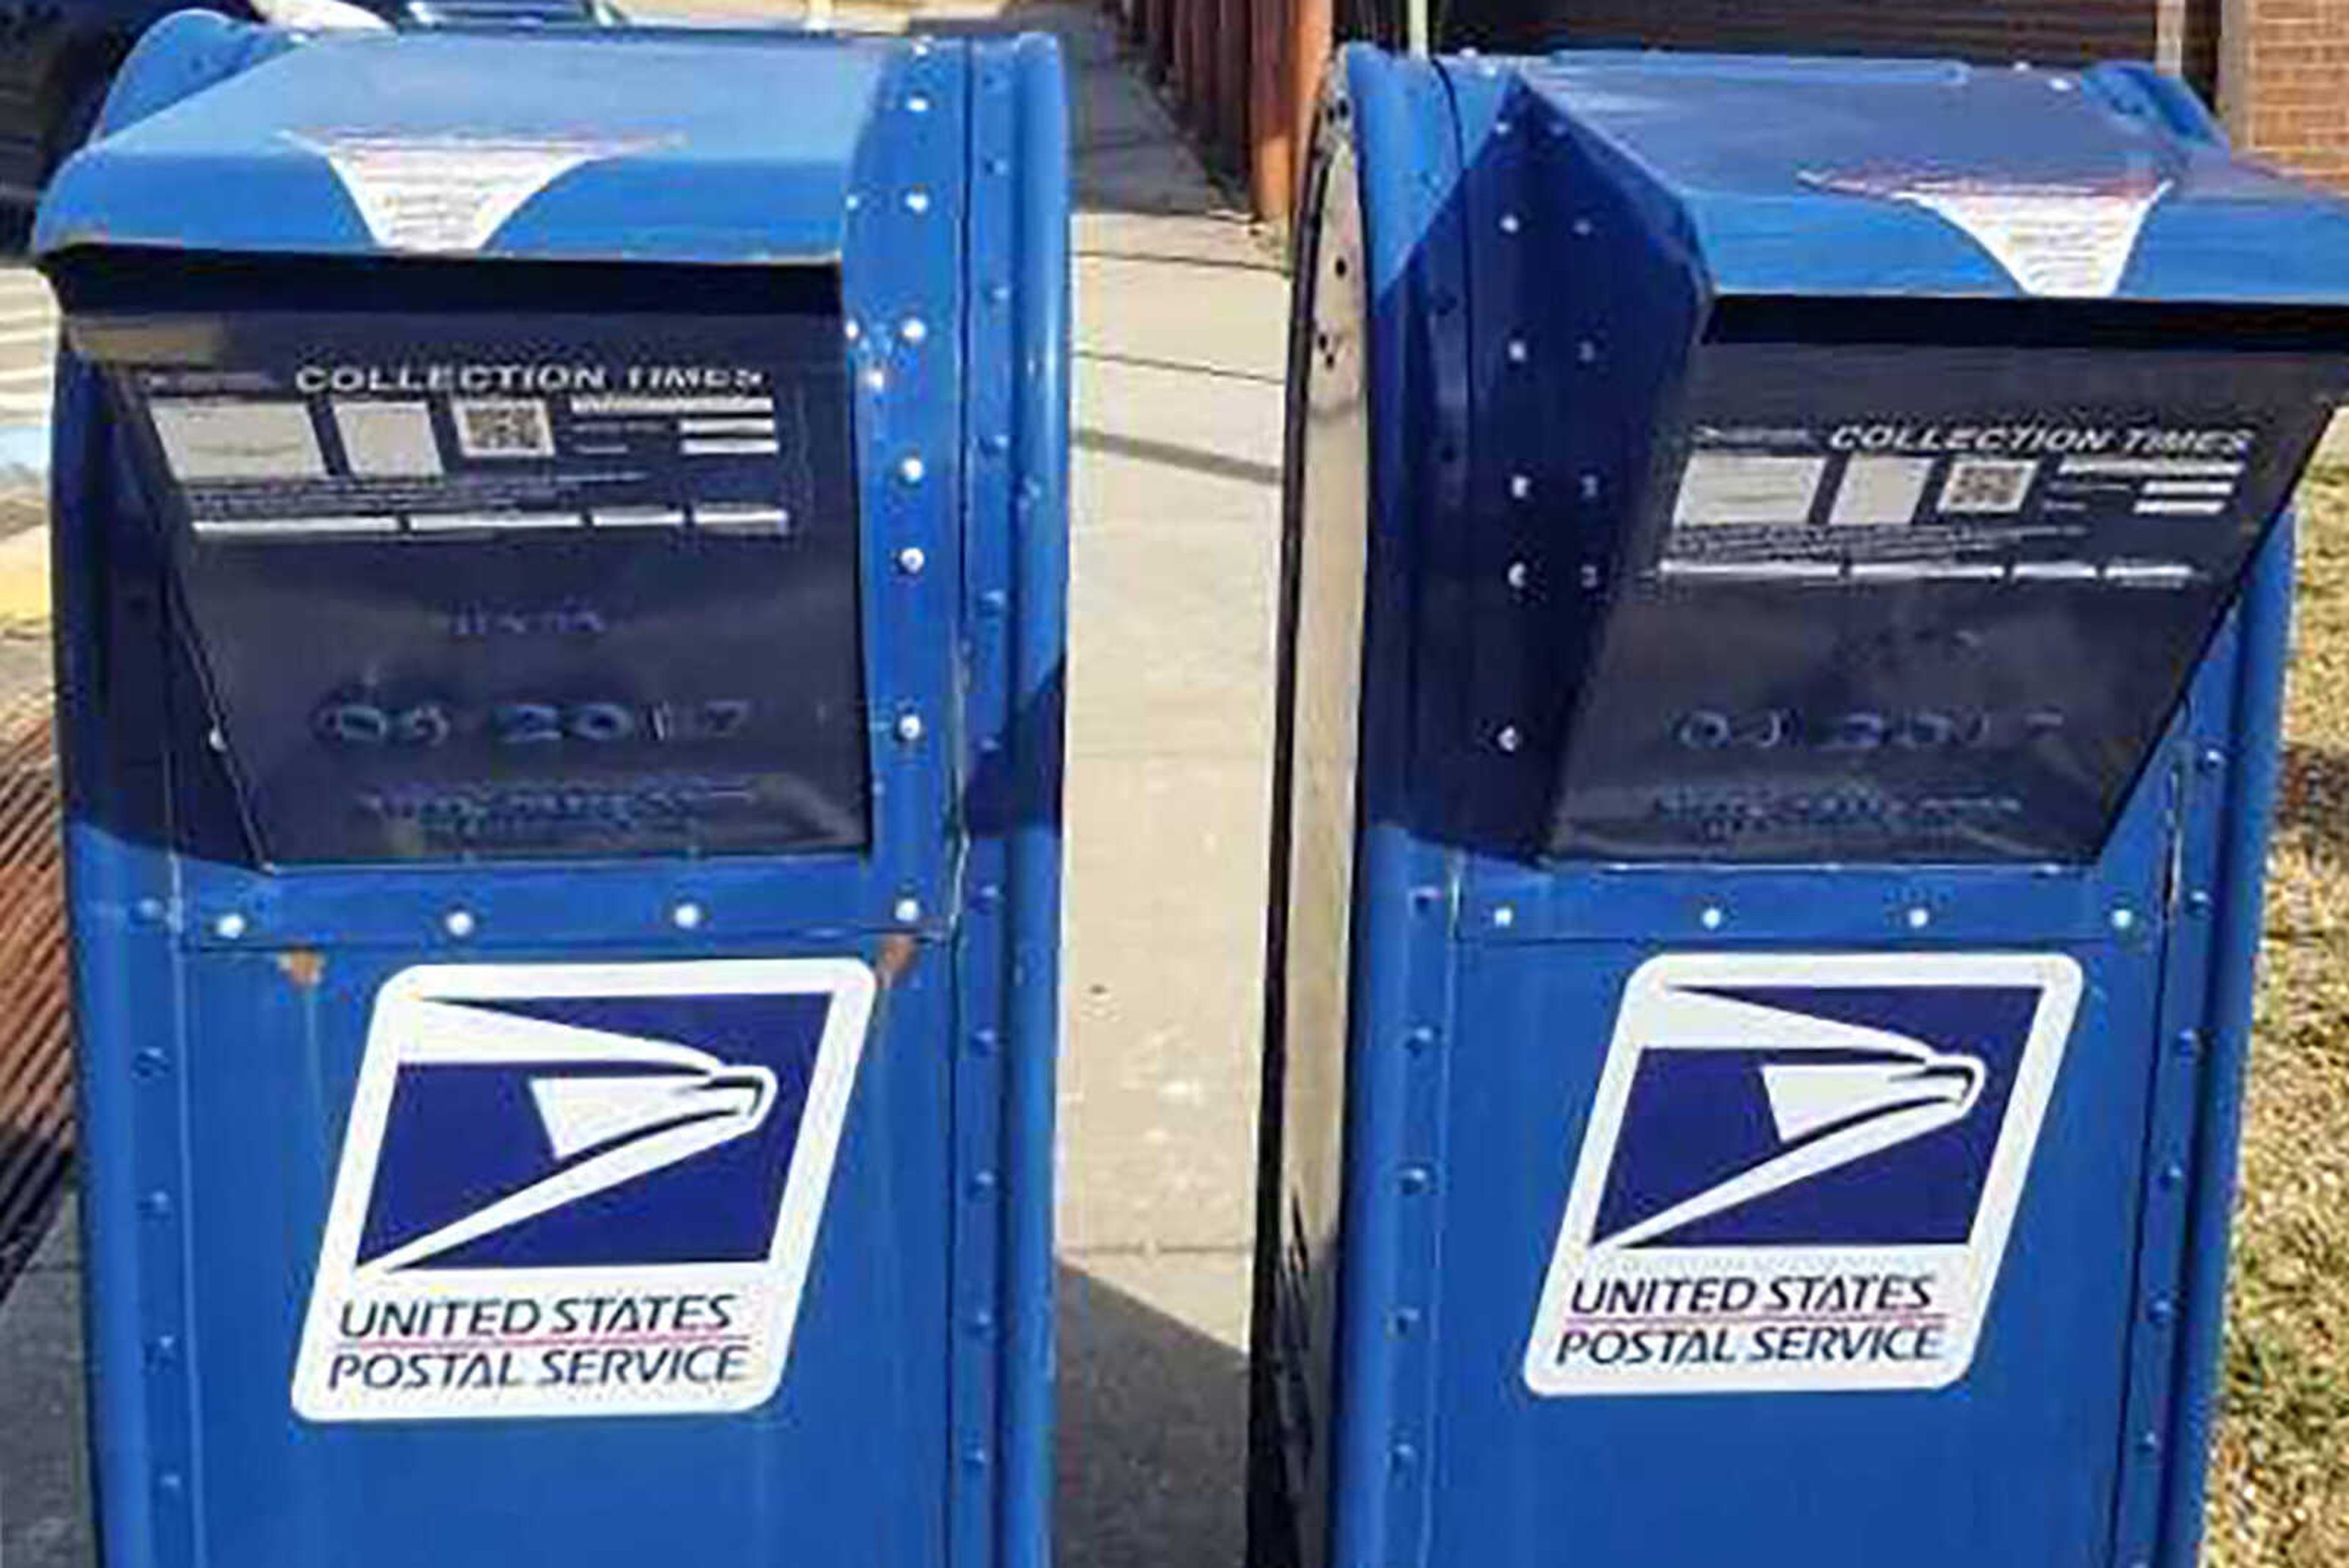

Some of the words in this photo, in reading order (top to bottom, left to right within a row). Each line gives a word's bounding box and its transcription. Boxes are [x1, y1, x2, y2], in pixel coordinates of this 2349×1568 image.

[295, 363, 606, 393] COLLECTION
[626, 365, 763, 392] TIMES
[1830, 426, 2109, 451] COLLECTION
[2121, 428, 2254, 454] TIMES
[1571, 1276, 1756, 1315] UNITED
[1765, 1273, 1937, 1311] STATES
[339, 1298, 541, 1337] UNITED
[551, 1293, 741, 1334] STATES
[1556, 1329, 1735, 1365] POSTAL
[1748, 1325, 1946, 1362] SERVICE
[328, 1351, 524, 1389] POSTAL
[538, 1344, 750, 1385] SERVICE
